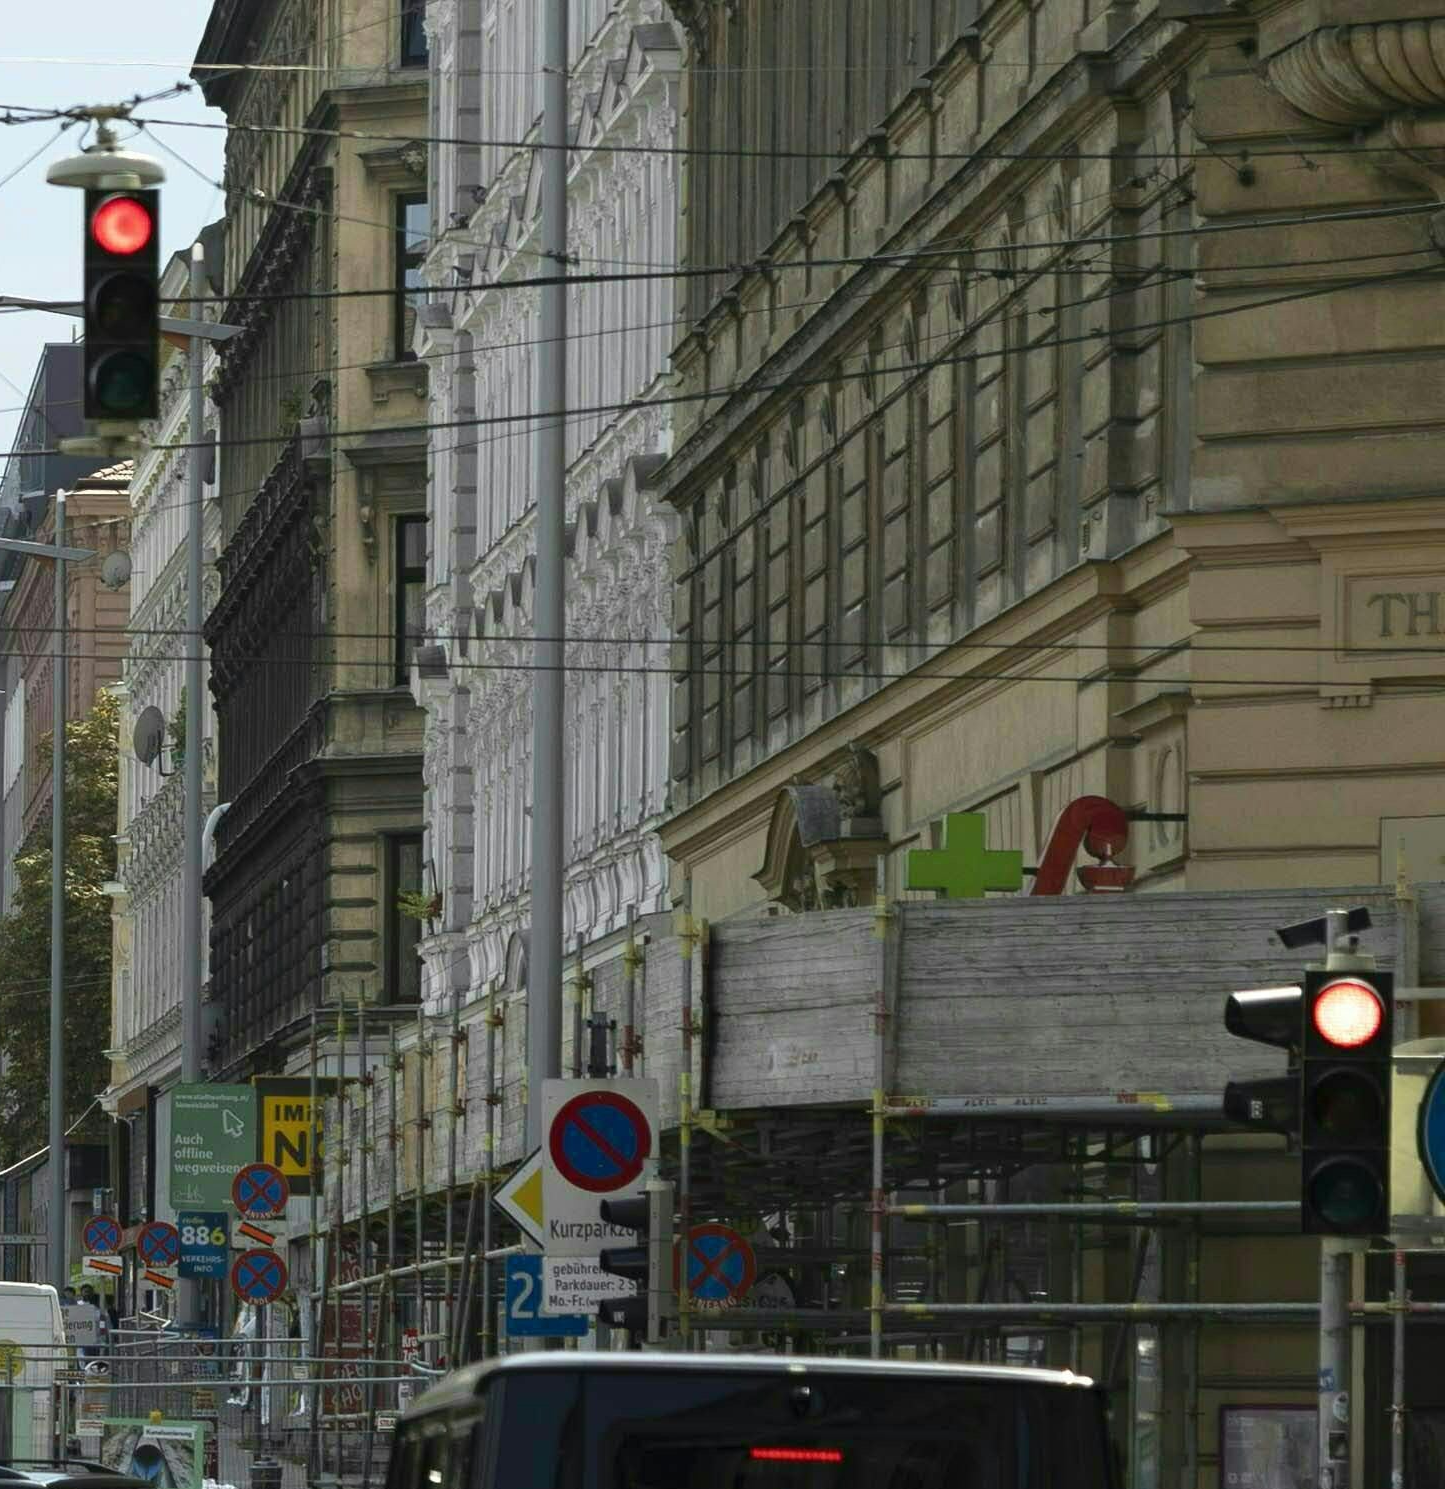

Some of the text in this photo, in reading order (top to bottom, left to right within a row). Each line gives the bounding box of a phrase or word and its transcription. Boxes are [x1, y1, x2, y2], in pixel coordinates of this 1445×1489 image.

[174, 1133, 203, 1145] Auch
[174, 1149, 213, 1160] offline
[181, 1226, 226, 1245] 886
[193, 1265, 213, 1273] INFO
[555, 1279, 614, 1291] Parkdauer:
[619, 1279, 625, 1290] 2
